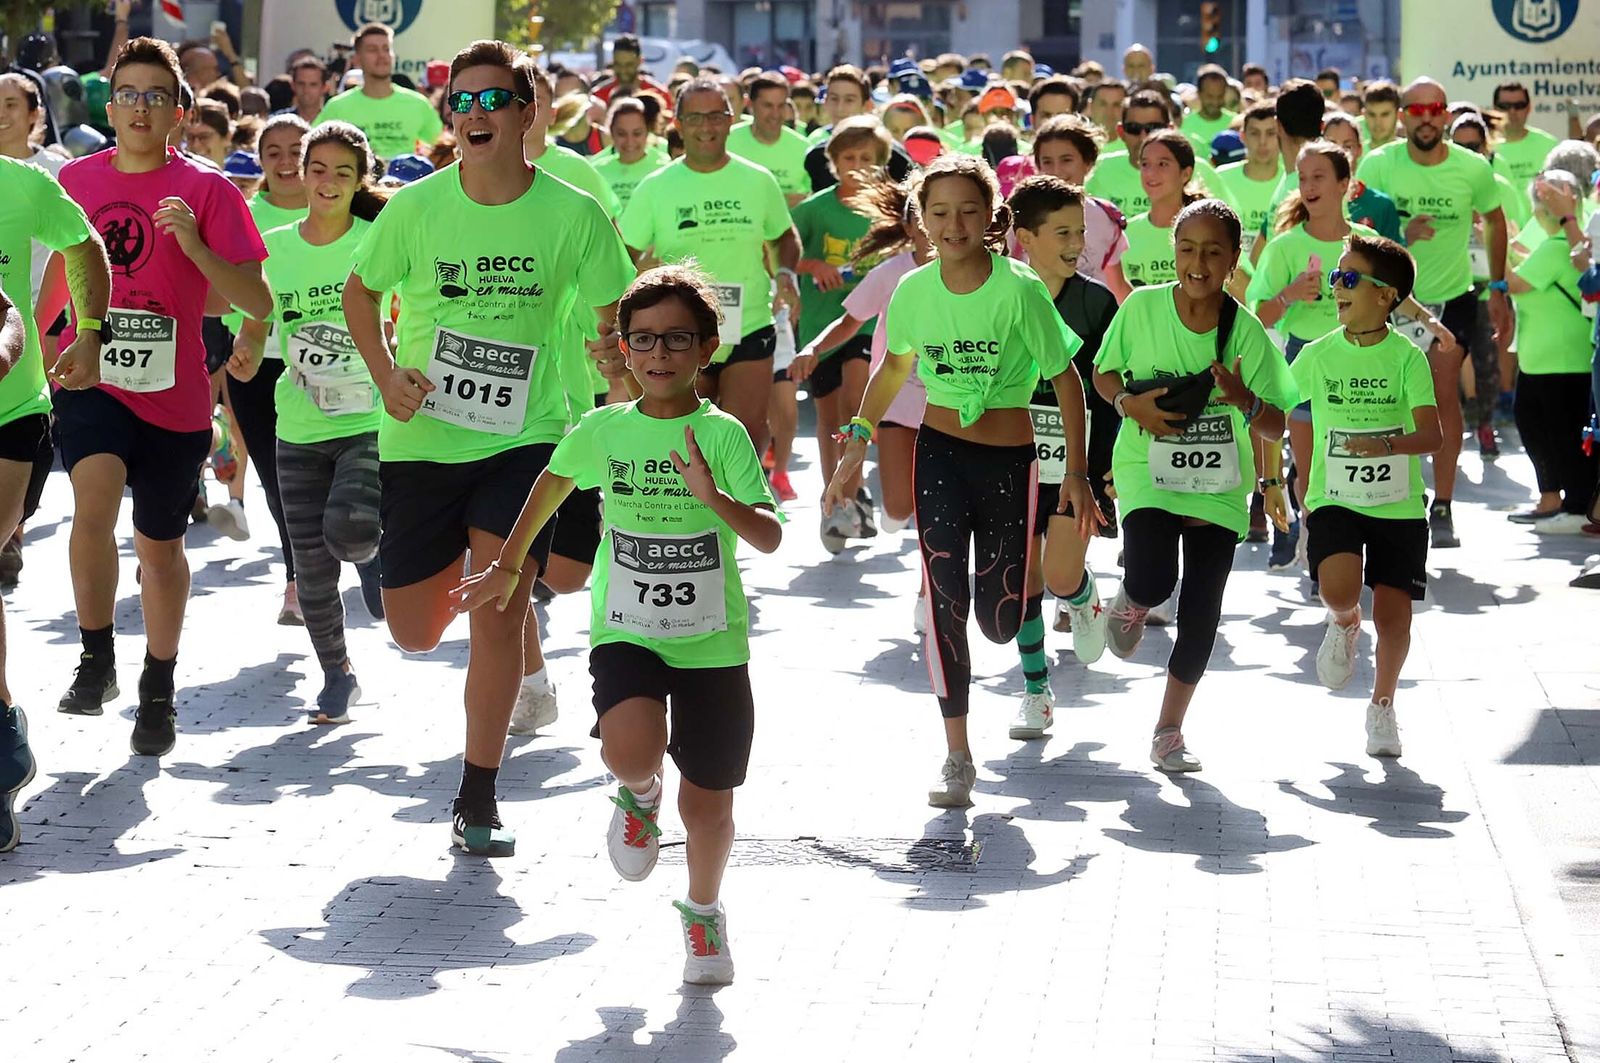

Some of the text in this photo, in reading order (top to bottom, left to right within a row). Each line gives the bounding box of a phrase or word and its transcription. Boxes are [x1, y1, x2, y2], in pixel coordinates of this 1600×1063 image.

[704, 199, 742, 210] aecc
[1418, 197, 1453, 207] aecc
[476, 256, 535, 273] aecc
[1150, 260, 1176, 272] aec
[479, 275, 515, 284] HUELVA
[308, 282, 344, 298] aec
[476, 283, 544, 297] en marcha
[478, 300, 506, 308] Contra
[118, 317, 161, 329] aecc
[133, 329, 169, 339] marcha
[322, 330, 356, 346] aec
[953, 340, 999, 355] aecc
[104, 348, 153, 368] 497
[473, 345, 520, 364] aecc
[486, 365, 527, 376] marcha
[1349, 377, 1388, 389] aecc
[443, 374, 513, 408] 1015
[1187, 420, 1227, 433] aecc
[1171, 451, 1222, 469] 802
[1345, 464, 1392, 483] 732
[644, 477, 679, 486] HUELVA
[641, 486, 660, 497] en
[644, 501, 672, 510] Contra
[647, 542, 705, 558] aecc
[647, 556, 717, 570] en marcha
[633, 580, 697, 608] 733
